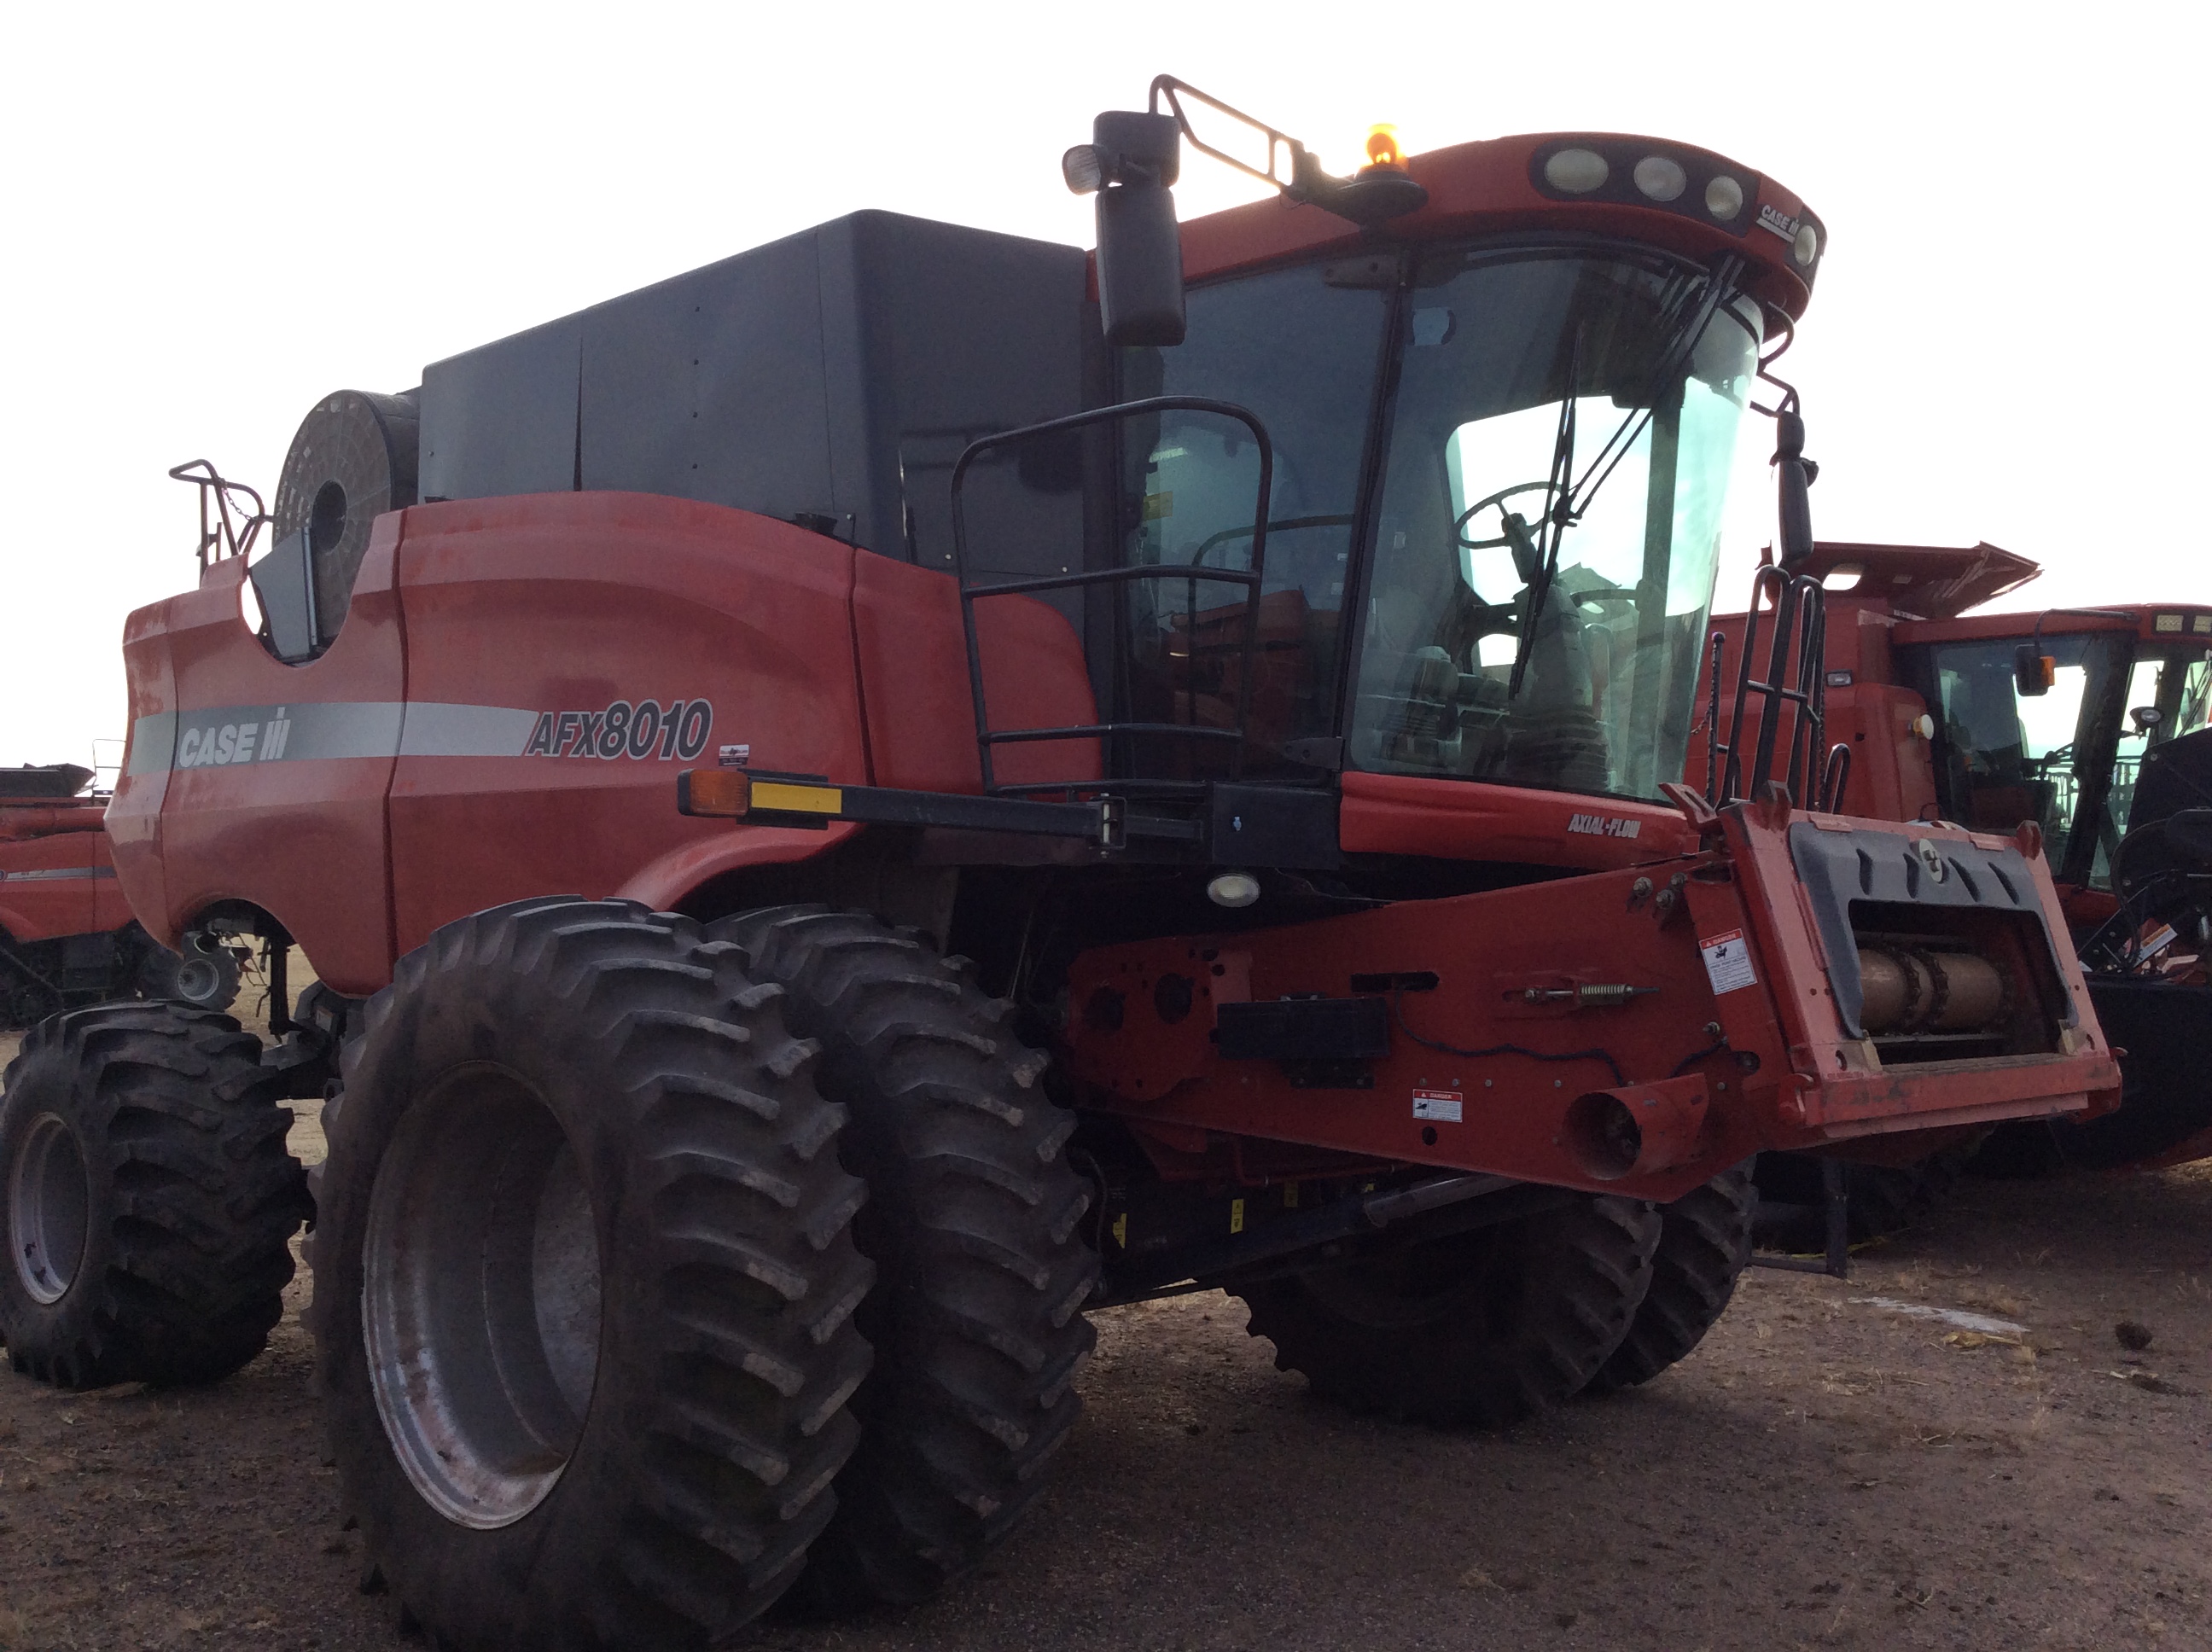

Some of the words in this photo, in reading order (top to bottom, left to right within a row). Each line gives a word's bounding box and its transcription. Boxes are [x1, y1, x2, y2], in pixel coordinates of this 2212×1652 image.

[1761, 205, 1790, 230] CASE
[179, 723, 259, 768] CASE
[525, 698, 713, 761] AFX8010
